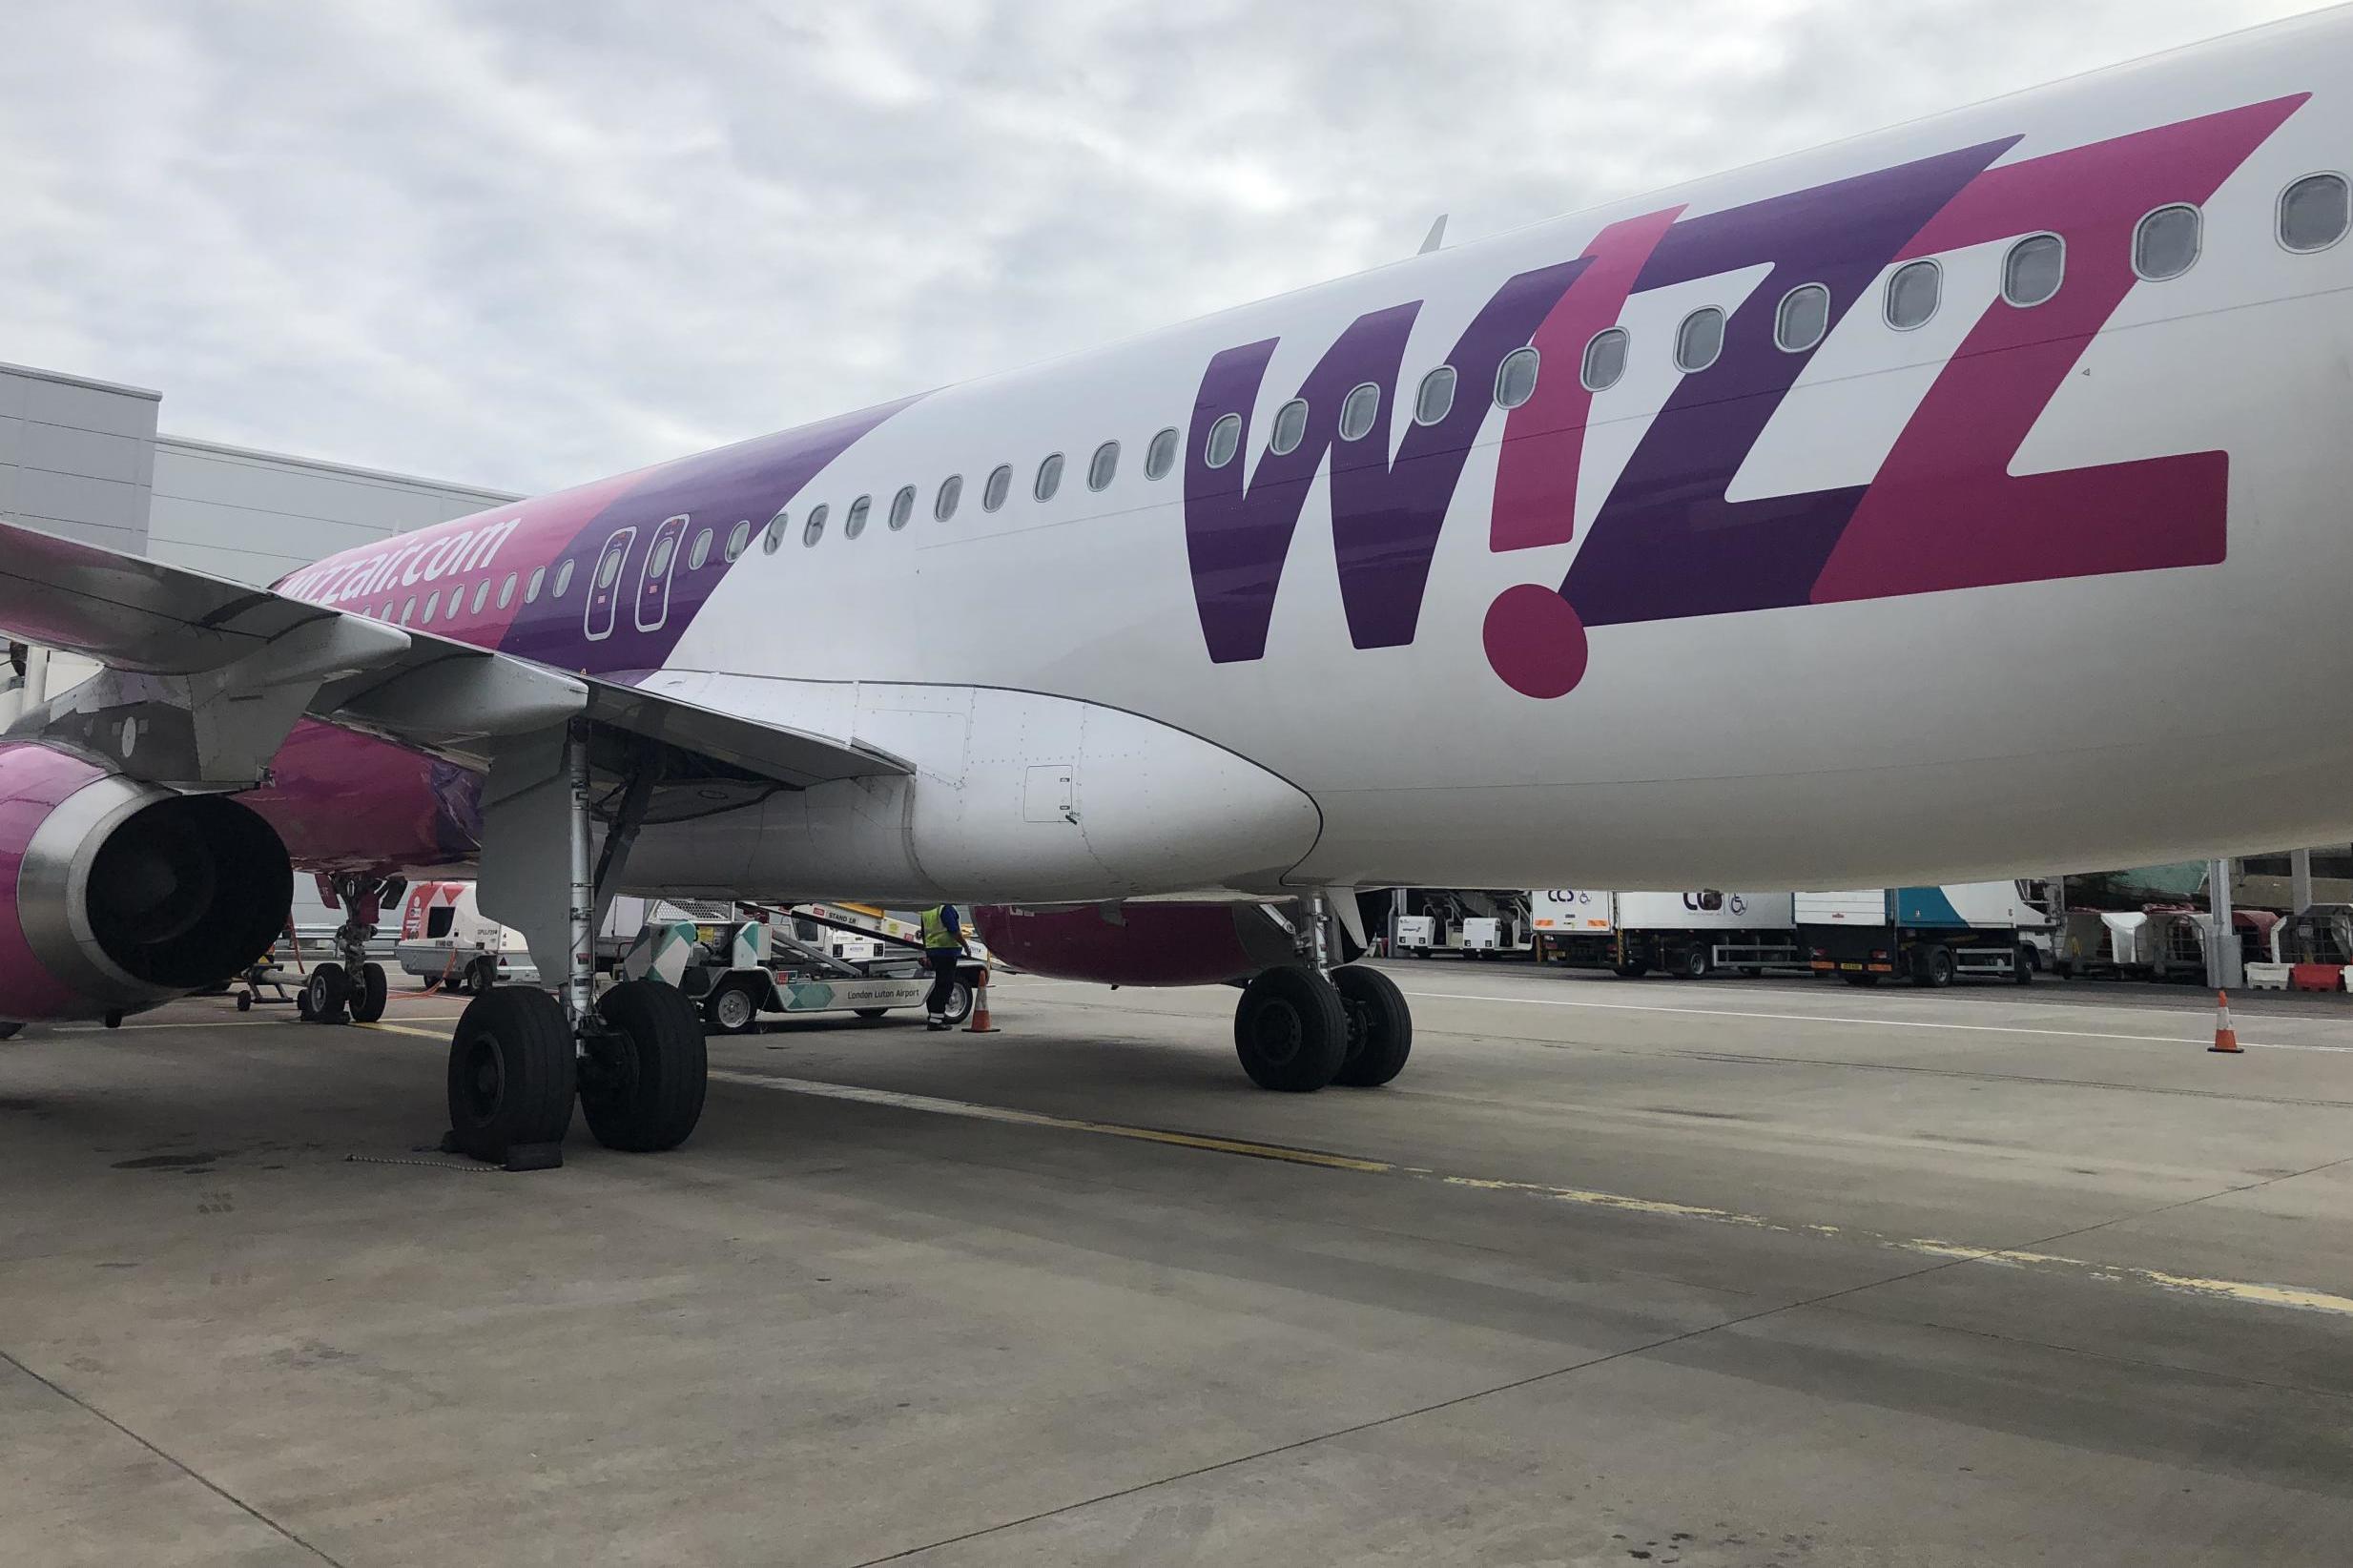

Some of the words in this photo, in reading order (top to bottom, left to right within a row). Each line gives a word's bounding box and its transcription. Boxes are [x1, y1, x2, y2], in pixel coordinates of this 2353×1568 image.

[847, 990, 873, 1000] London
[874, 990, 895, 999] Luton
[896, 988, 919, 999] Airport
